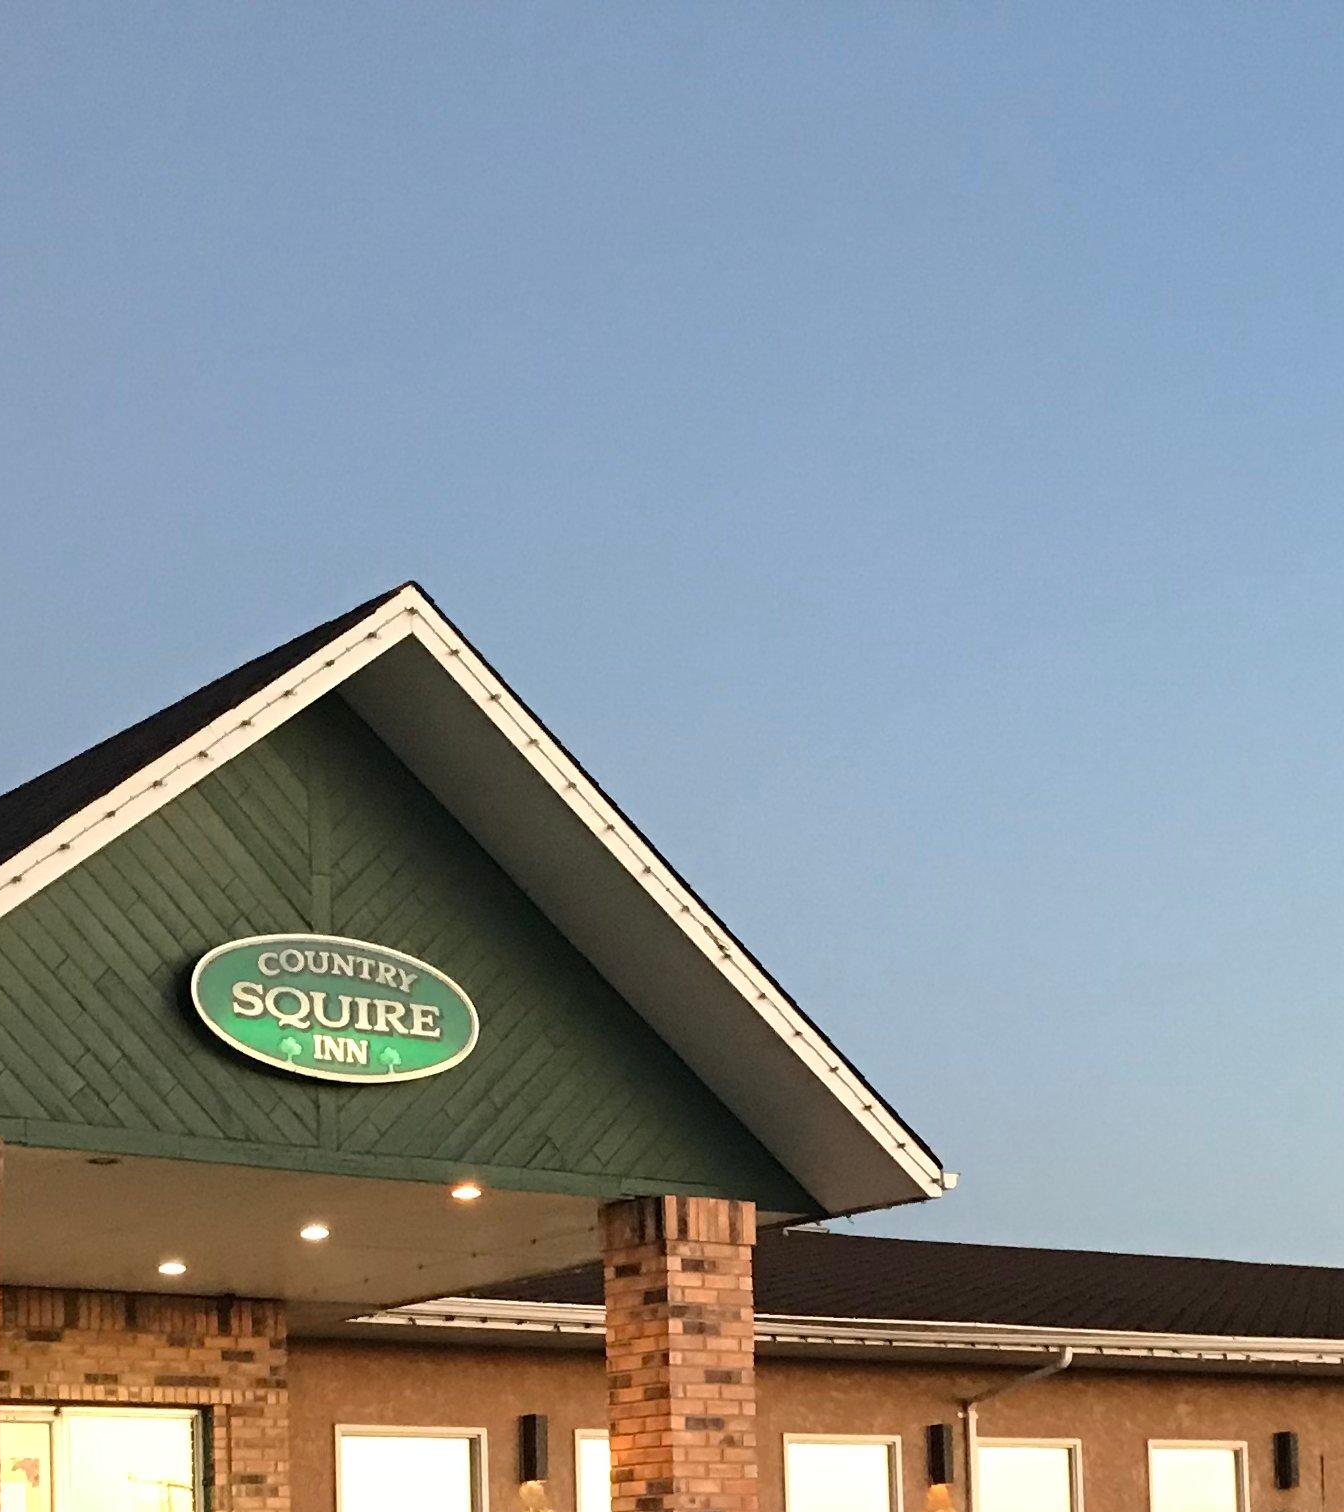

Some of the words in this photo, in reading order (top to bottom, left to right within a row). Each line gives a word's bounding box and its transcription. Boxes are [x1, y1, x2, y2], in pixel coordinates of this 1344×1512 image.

[258, 949, 418, 993] COUNTRY
[232, 981, 440, 1038] SQUIRE
[313, 1034, 368, 1065] INN
